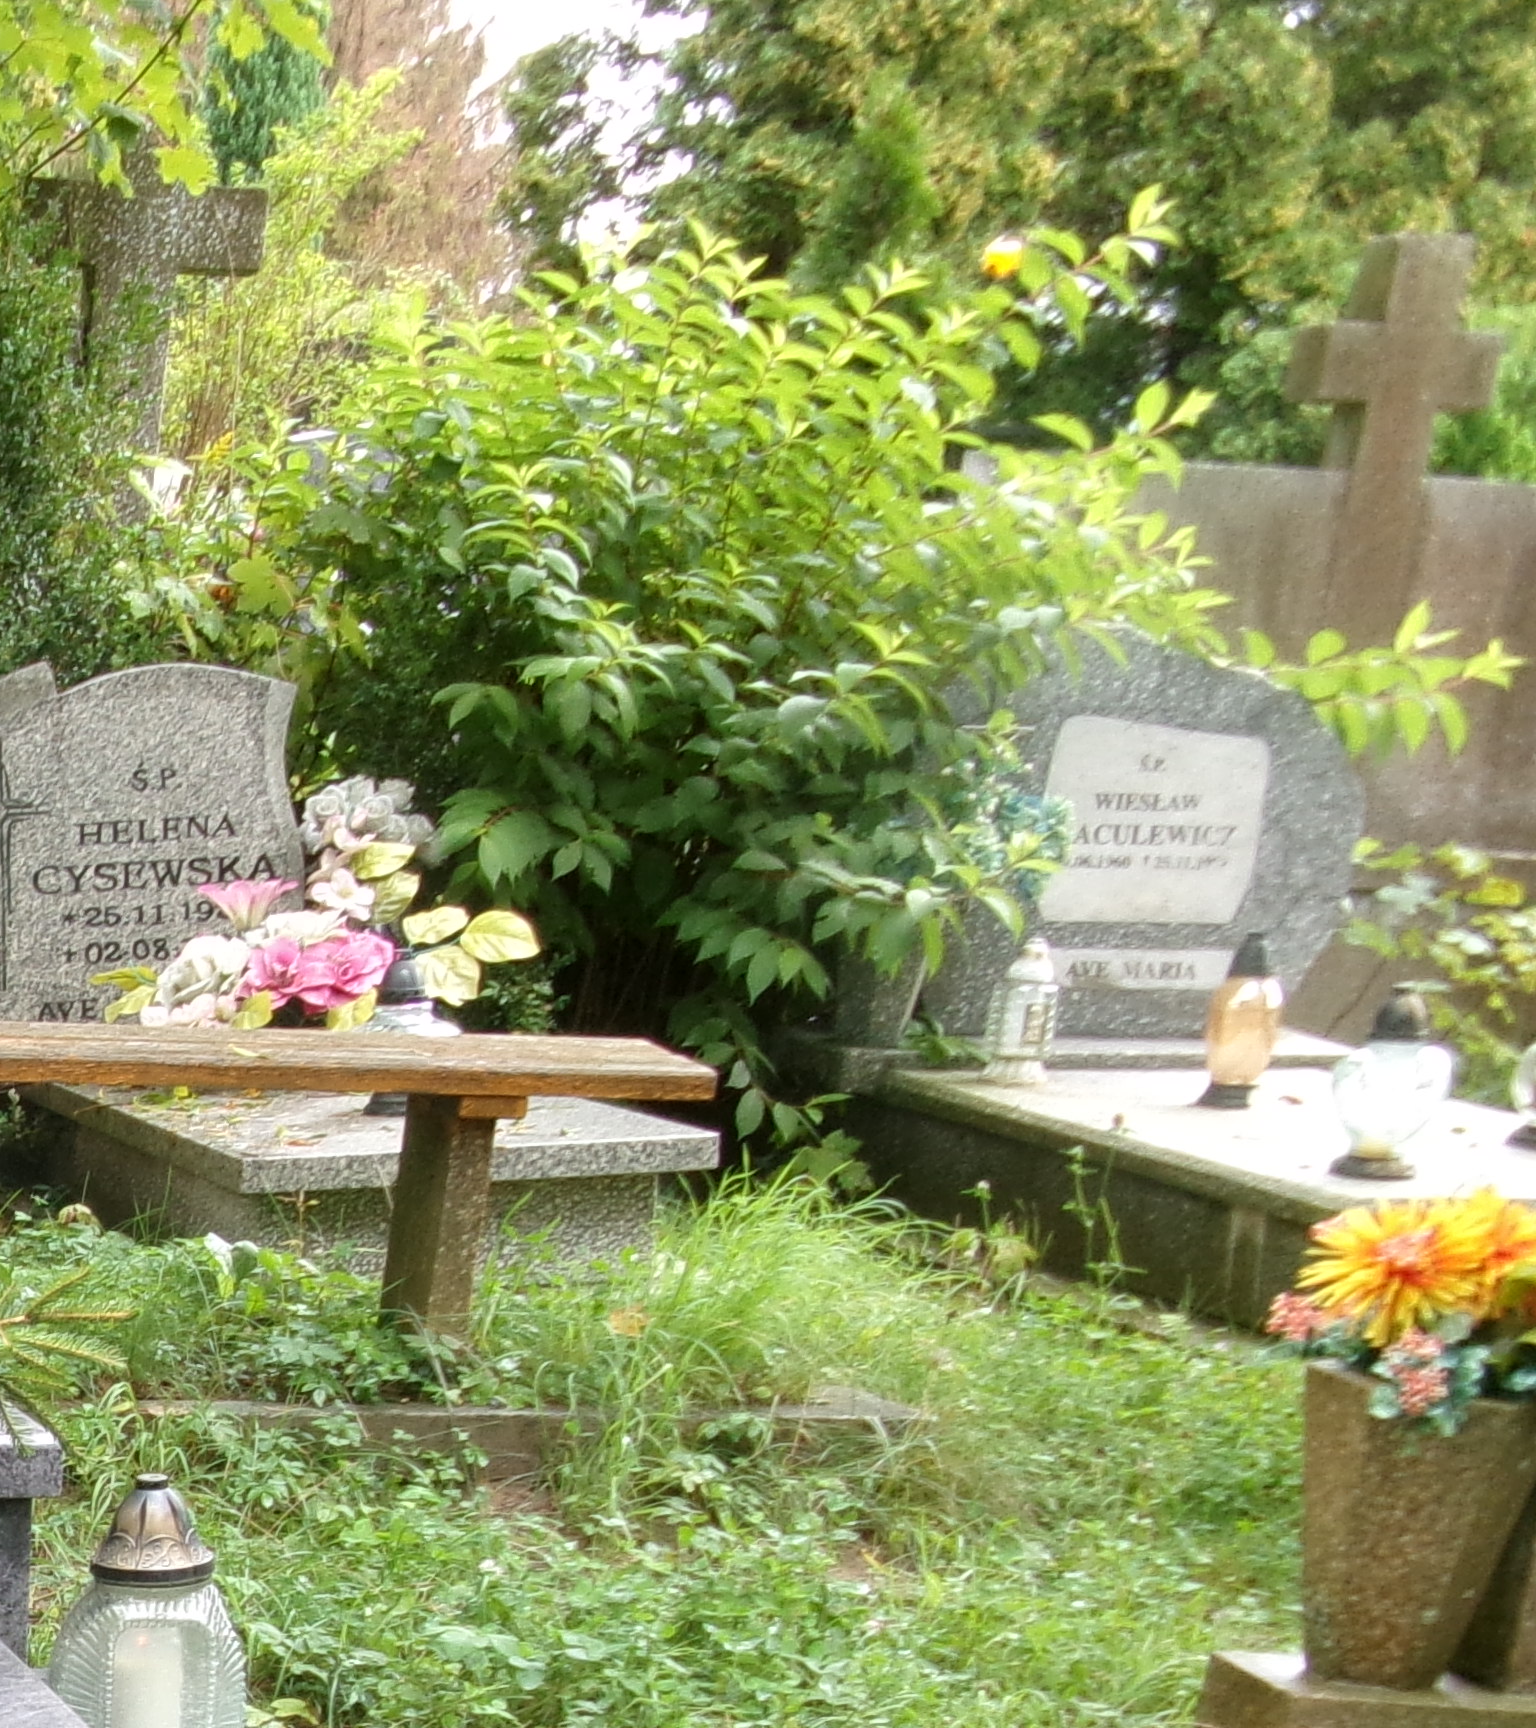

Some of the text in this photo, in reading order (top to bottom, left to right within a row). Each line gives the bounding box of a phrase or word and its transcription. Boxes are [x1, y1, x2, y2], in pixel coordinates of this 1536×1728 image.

[1094, 792, 1198, 812] WIESŁAW
[76, 815, 236, 846] HELENA
[1072, 822, 1237, 846] ACULEWICZ
[32, 853, 276, 895] CYSEWSKA
[37, 1001, 98, 1022] AVE
